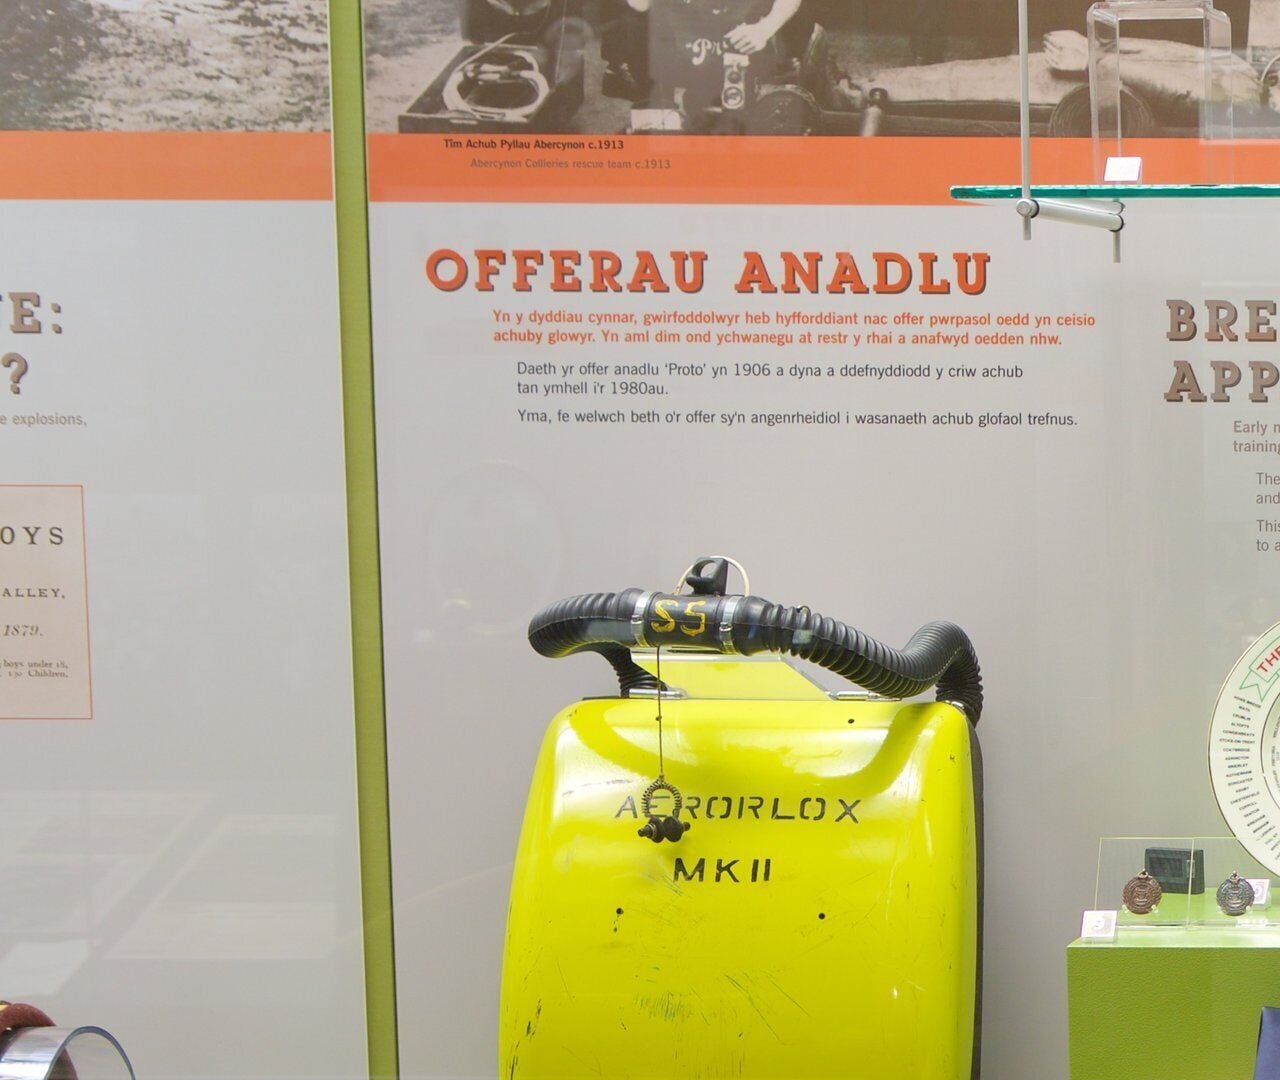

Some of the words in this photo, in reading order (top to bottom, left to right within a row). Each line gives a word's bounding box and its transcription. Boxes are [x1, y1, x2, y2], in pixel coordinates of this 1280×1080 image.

[443, 138, 462, 149] Tîm
[466, 139, 497, 148] Achub
[501, 139, 530, 151] Pyllau
[534, 140, 585, 151] Abercynon
[588, 140, 624, 149] c.1913
[470, 158, 521, 170] Abercynon
[525, 158, 568, 168] Collieries
[573, 160, 604, 168] rescue
[608, 160, 631, 168] team
[635, 159, 671, 169] c.1913
[426, 249, 708, 294] OFFERAU
[734, 252, 991, 296] ANADLU
[493, 310, 510, 322] Yn
[516, 313, 523, 325] y
[529, 310, 582, 325] dyddiau
[588, 313, 637, 325] cynnar,
[643, 311, 740, 327] gwirfoddolwyr
[745, 312, 770, 324] heb
[776, 312, 858, 327] hyfforddiant
[864, 315, 887, 325] nac
[893, 312, 924, 325] offer
[930, 313, 990, 328] pwrpasol
[997, 313, 1029, 325] oedd
[1035, 316, 1051, 328] yn
[1057, 313, 1095, 326] ceisio
[518, 382, 538, 394] tan
[544, 382, 587, 397] ymhell
[594, 381, 605, 394] i'r
[612, 382, 668, 395] 1980au.
[12, 412, 88, 428] explosions,
[518, 409, 551, 424] Yma,
[557, 409, 569, 422] fe
[575, 410, 625, 422] welwch
[631, 410, 659, 423] beth
[665, 411, 681, 423] o'r
[686, 410, 715, 423] offer
[721, 411, 745, 426] sy'n
[751, 411, 840, 426] angenrheidiol
[846, 412, 849, 424] i
[855, 412, 926, 424] wasanaeth
[932, 412, 973, 425] achub
[979, 412, 1021, 428] glofaol
[1028, 412, 1077, 425] trefnus.
[1234, 420, 1267, 436] Early
[1256, 539, 1269, 551] to
[2, 587, 66, 600] ALLEY,
[3, 624, 43, 636] 1879.
[614, 796, 862, 824] AERORLOX
